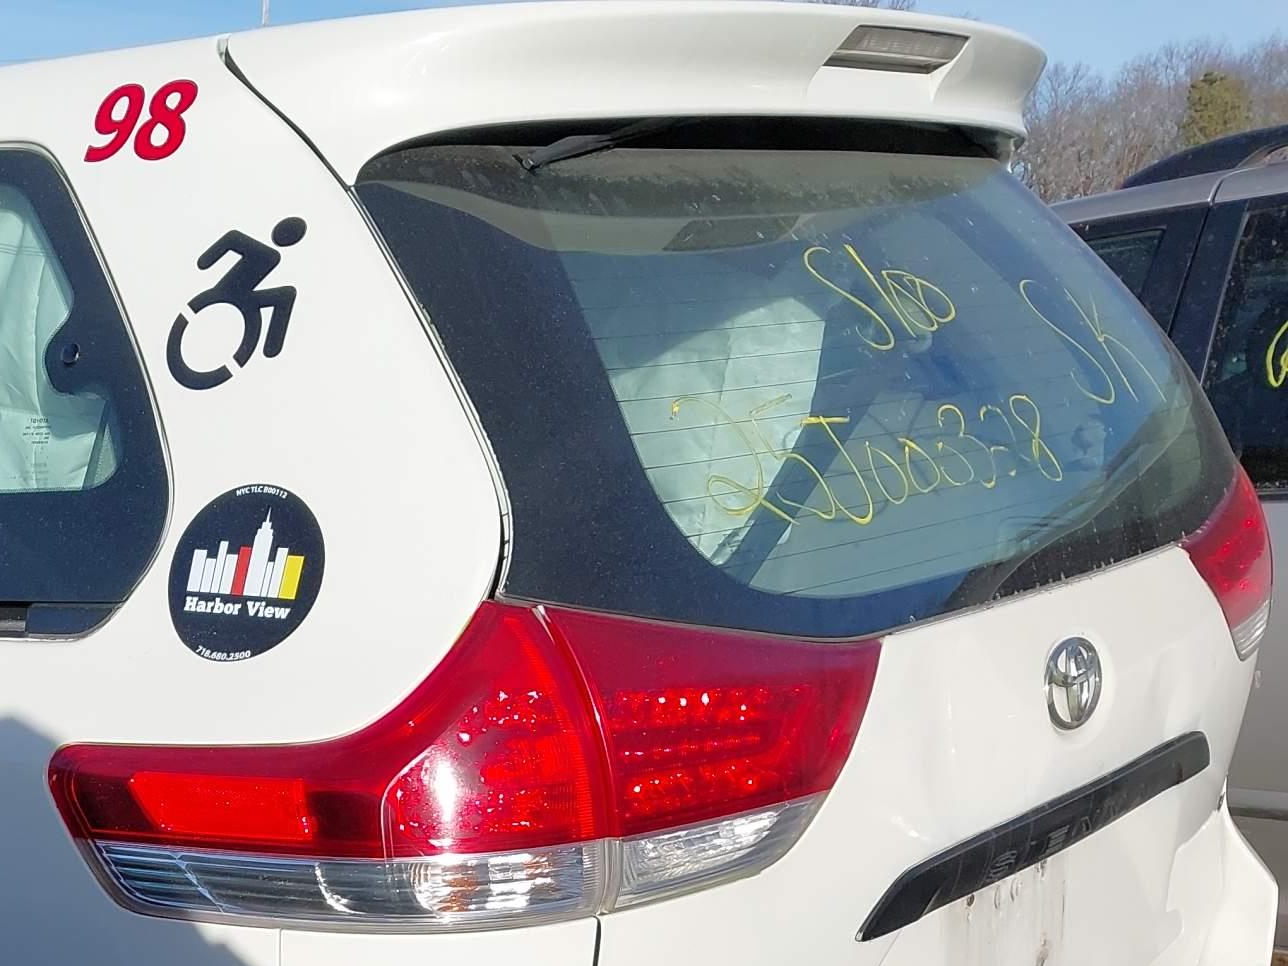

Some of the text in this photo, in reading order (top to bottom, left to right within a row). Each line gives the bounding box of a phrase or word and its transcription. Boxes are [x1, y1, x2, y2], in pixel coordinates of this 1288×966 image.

[83, 79, 199, 163] 98
[235, 486, 250, 497] NYC
[250, 485, 264, 493] TLC
[184, 596, 291, 620] Harbor View
[195, 645, 252, 661] 718.680.2500
